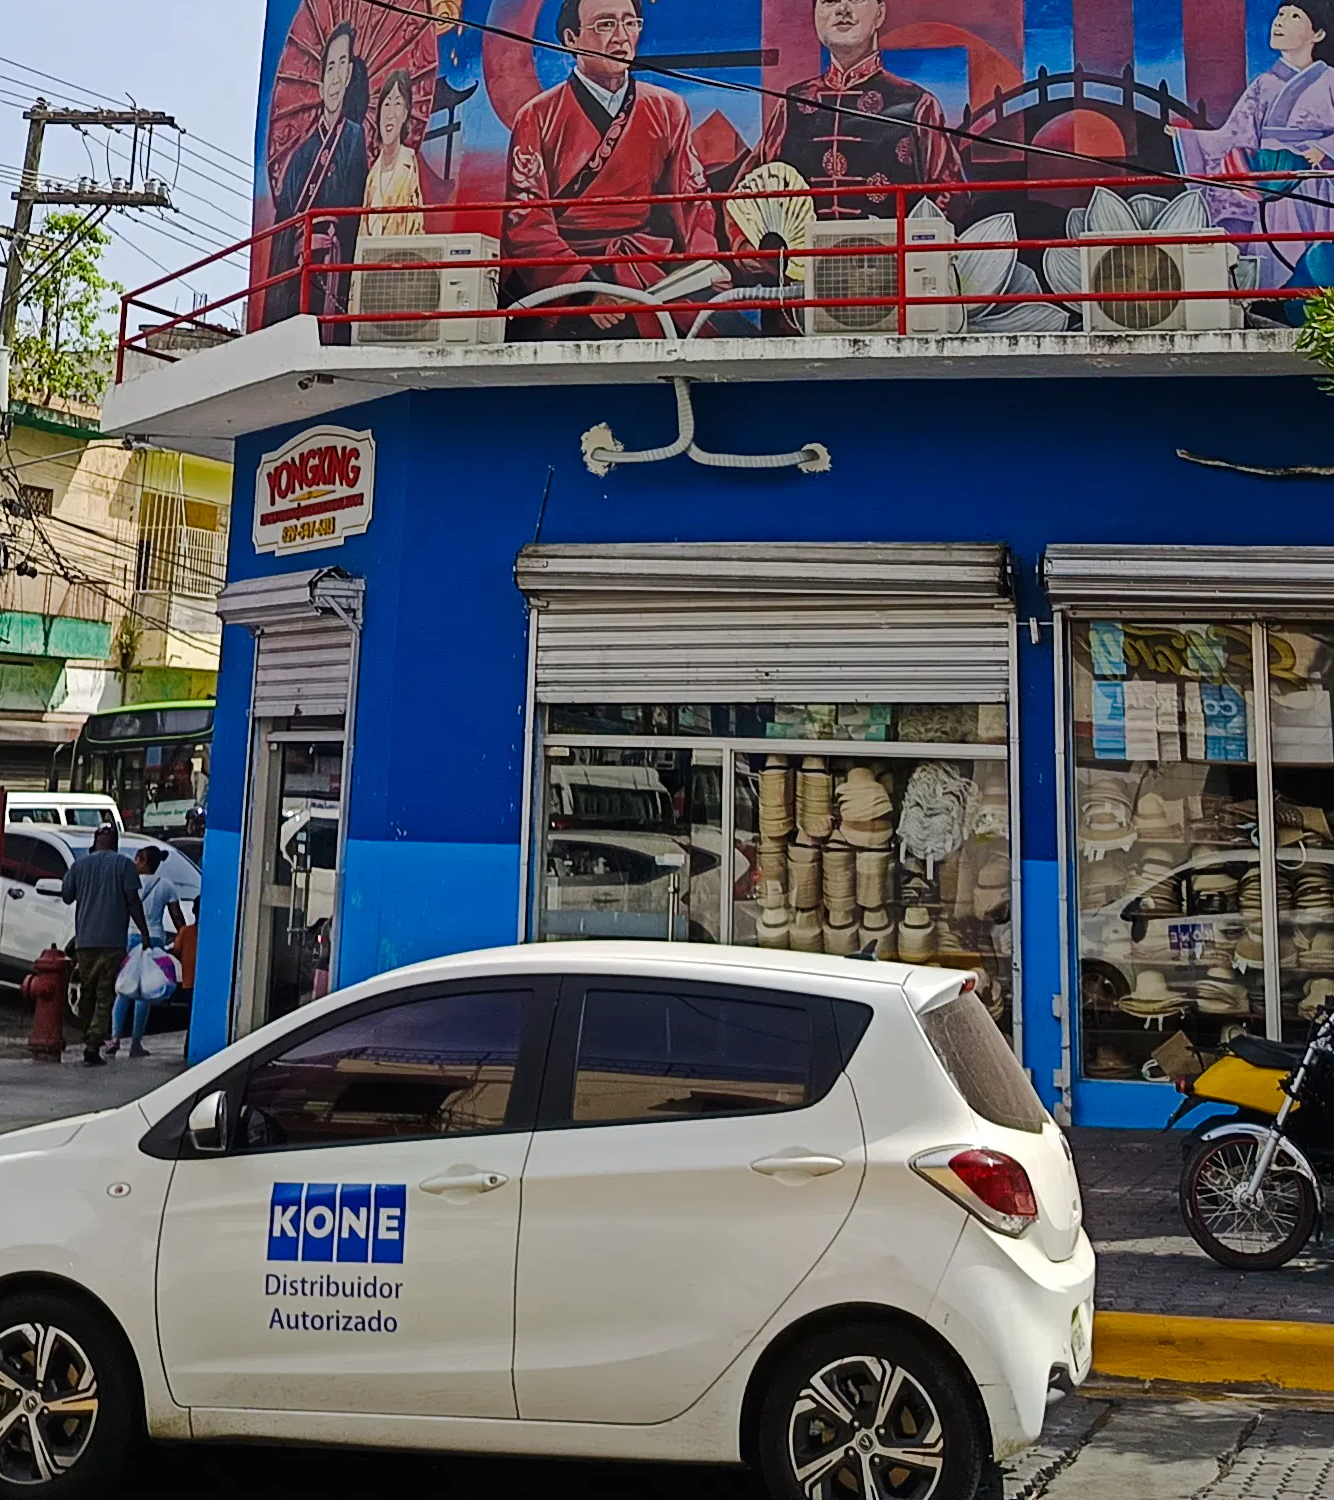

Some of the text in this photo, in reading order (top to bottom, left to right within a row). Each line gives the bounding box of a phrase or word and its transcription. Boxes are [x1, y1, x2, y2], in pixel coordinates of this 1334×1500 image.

[266, 445, 362, 507] YONGXING
[272, 1205, 401, 1241] KONE
[265, 1273, 403, 1299] Distribuidor
[269, 1307, 398, 1333] Autorizado
